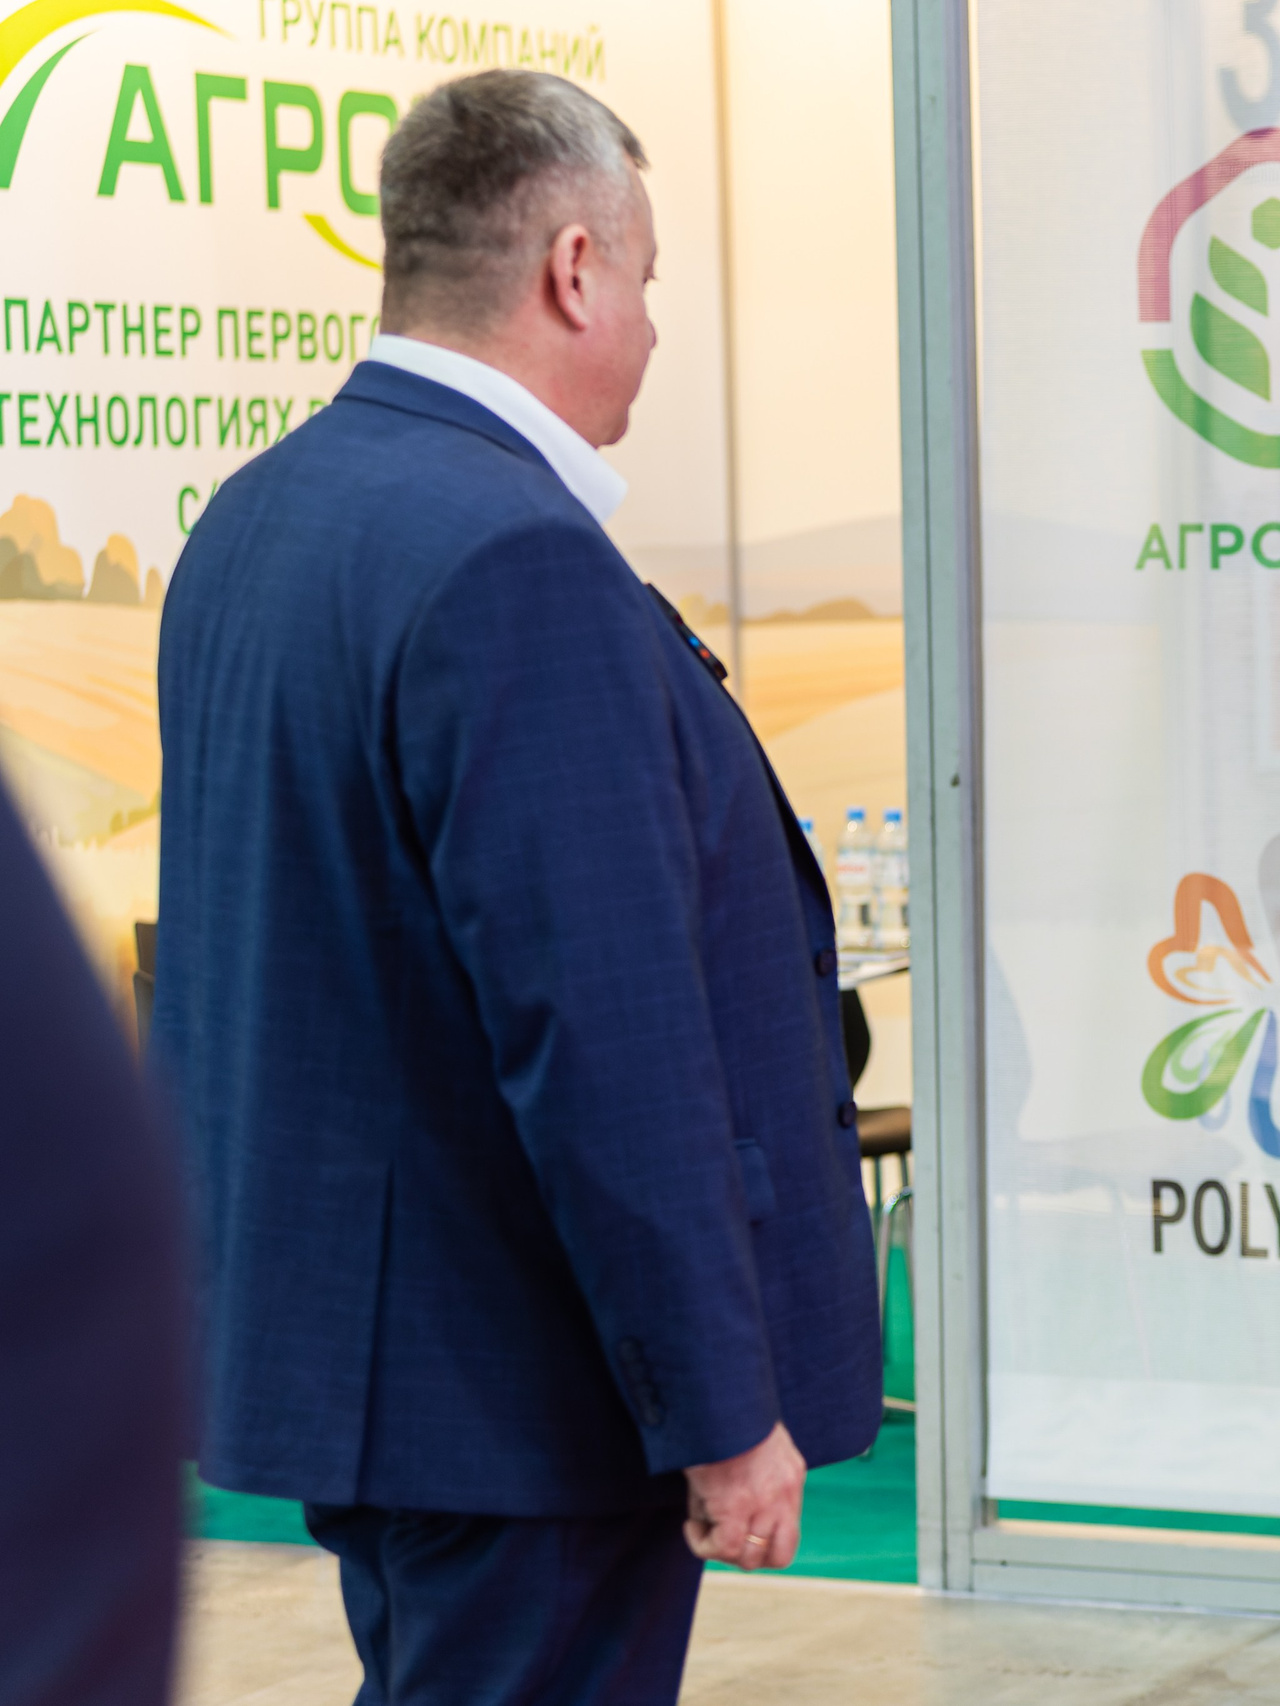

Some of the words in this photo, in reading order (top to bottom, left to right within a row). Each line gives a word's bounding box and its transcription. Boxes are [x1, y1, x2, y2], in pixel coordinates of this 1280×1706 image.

[257, 0, 403, 56] ГРУППА
[415, 12, 605, 80] КОМПАНИЙ
[97, 62, 424, 217] АГРО
[3, 297, 201, 358] ПАРТНЕР
[217, 308, 381, 361] ПЕРВОГ
